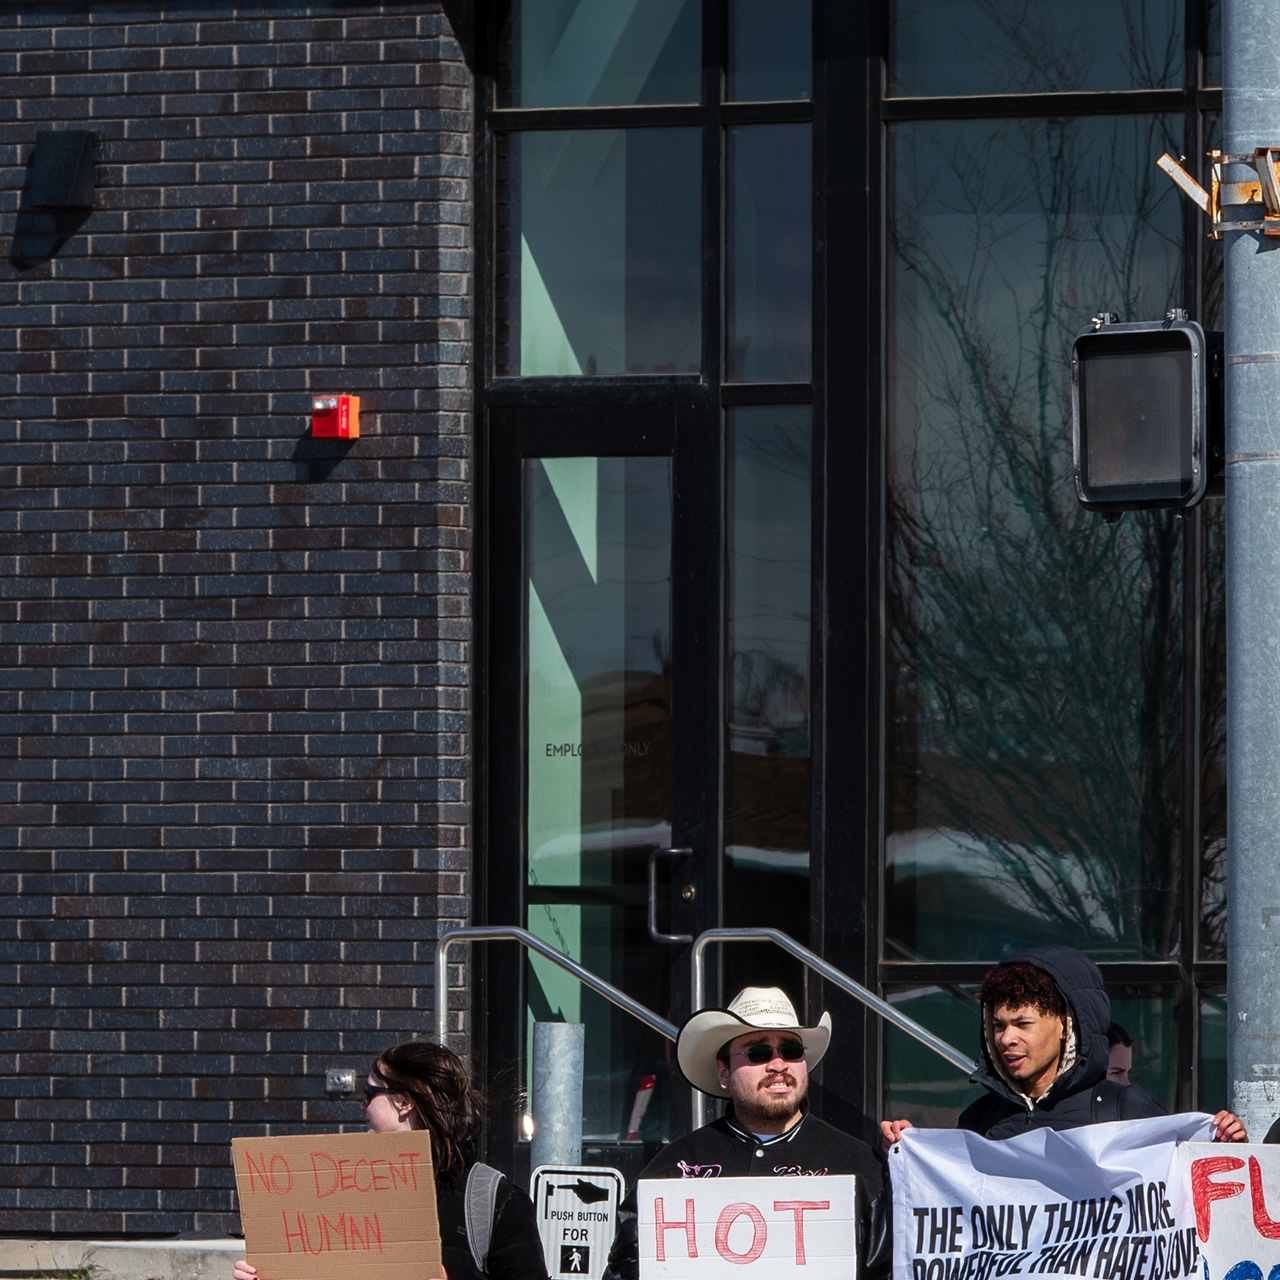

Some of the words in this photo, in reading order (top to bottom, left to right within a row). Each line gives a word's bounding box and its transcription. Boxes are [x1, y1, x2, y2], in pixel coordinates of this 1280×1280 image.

[245, 1151, 292, 1196] NO
[310, 1152, 420, 1199] DECENT
[282, 1209, 383, 1255] HUMAN
[550, 1210, 574, 1222] PUSH
[577, 1211, 609, 1223] BUTTON
[562, 1228, 589, 1241] FOR
[654, 1197, 830, 1265] HOT
[912, 1206, 963, 1254] THE
[970, 1205, 1038, 1251] ONLY
[1042, 1195, 1123, 1245] THING
[1125, 1181, 1176, 1234] MORE
[1028, 1238, 1098, 1275] THAN
[1164, 1226, 1200, 1280] LOVE
